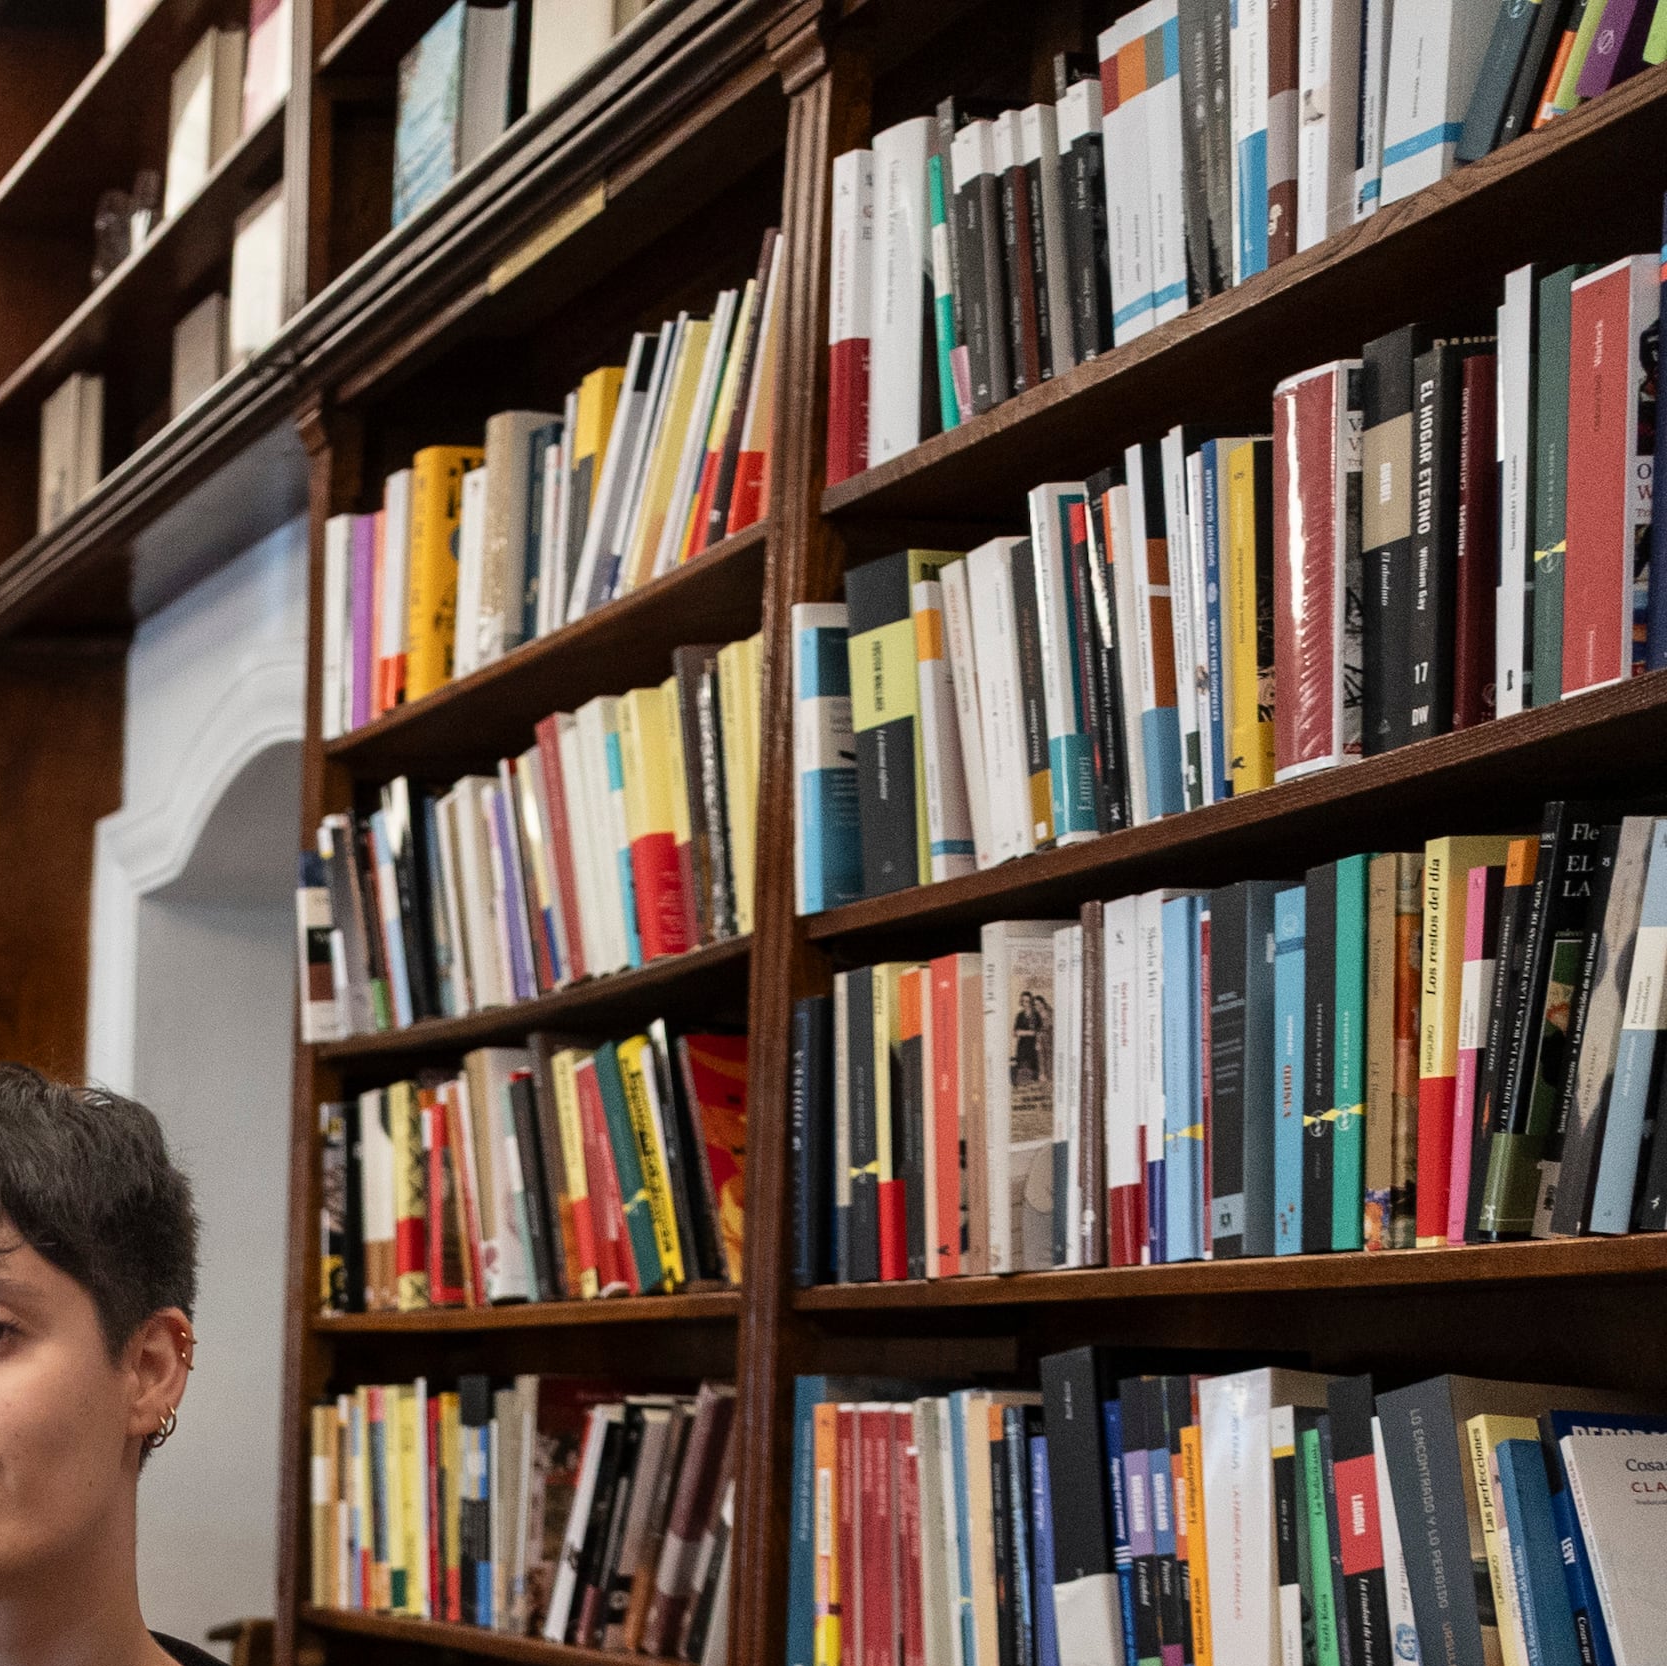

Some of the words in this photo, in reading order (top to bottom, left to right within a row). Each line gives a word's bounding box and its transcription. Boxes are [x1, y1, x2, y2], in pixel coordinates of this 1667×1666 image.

[1419, 379, 1434, 402] EL
[1418, 405, 1434, 464] HOGAR
[1416, 468, 1432, 535] ETERNO
[1416, 546, 1430, 588] William
[1415, 590, 1429, 611] Gay
[1414, 661, 1429, 685] 17
[1428, 858, 1441, 882] día
[1427, 885, 1440, 911] del
[1427, 915, 1441, 965] restos
[1426, 968, 1439, 996] Los
[1409, 1408, 1426, 1426] LO
[1411, 1428, 1435, 1514] ENCONTRADO
[1470, 1427, 1494, 1512] perfecciones
[1483, 1514, 1496, 1534] Las
[1428, 1529, 1439, 1546] LO
[1430, 1550, 1449, 1609] PERDIDO
[1359, 1592, 1372, 1626] ciudad
[1576, 1616, 1590, 1642] Cosas
[1579, 1644, 1592, 1661] que
